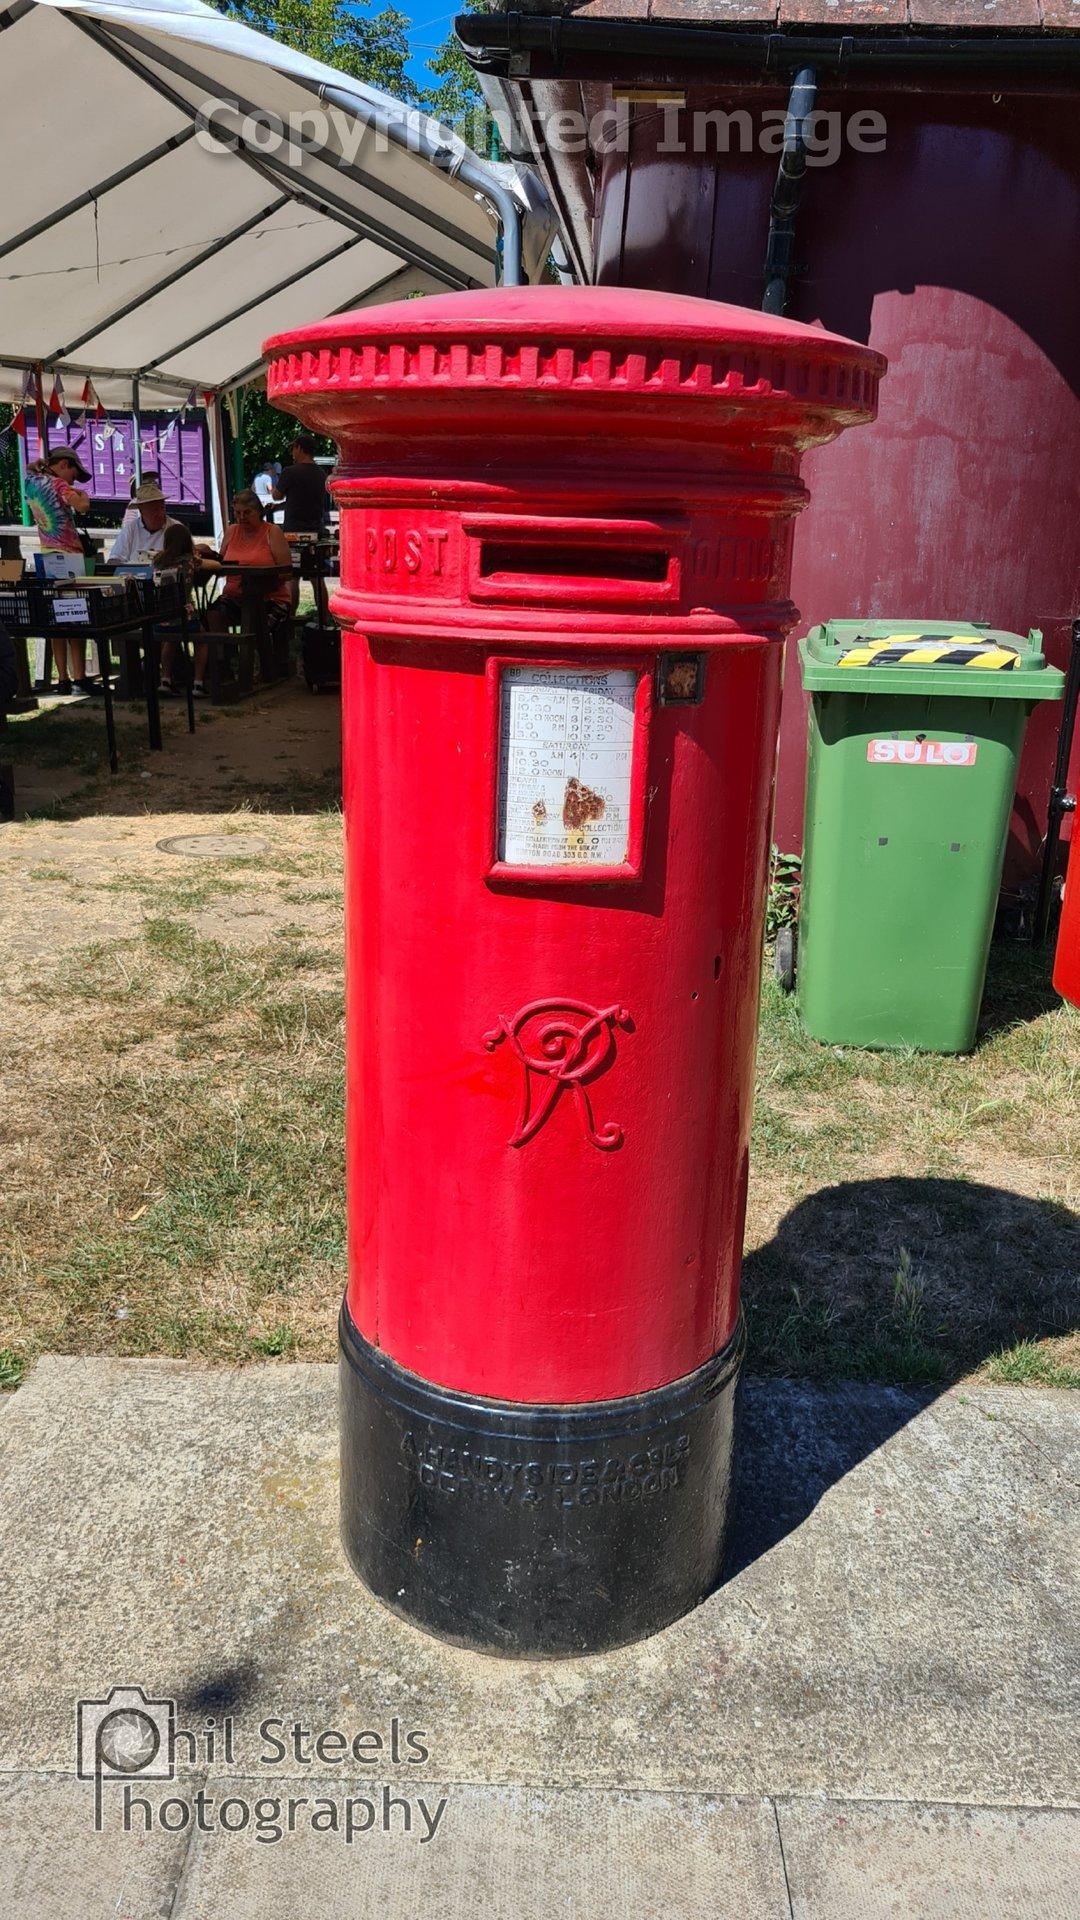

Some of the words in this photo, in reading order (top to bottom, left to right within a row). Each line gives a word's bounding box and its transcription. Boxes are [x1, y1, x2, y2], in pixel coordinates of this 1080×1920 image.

[366, 527, 449, 577] POST
[531, 673, 608, 685] COLLECTIONS
[583, 687, 616, 695] FRIDAY
[542, 740, 590, 750] SATURDAY
[873, 741, 969, 764] SULO
